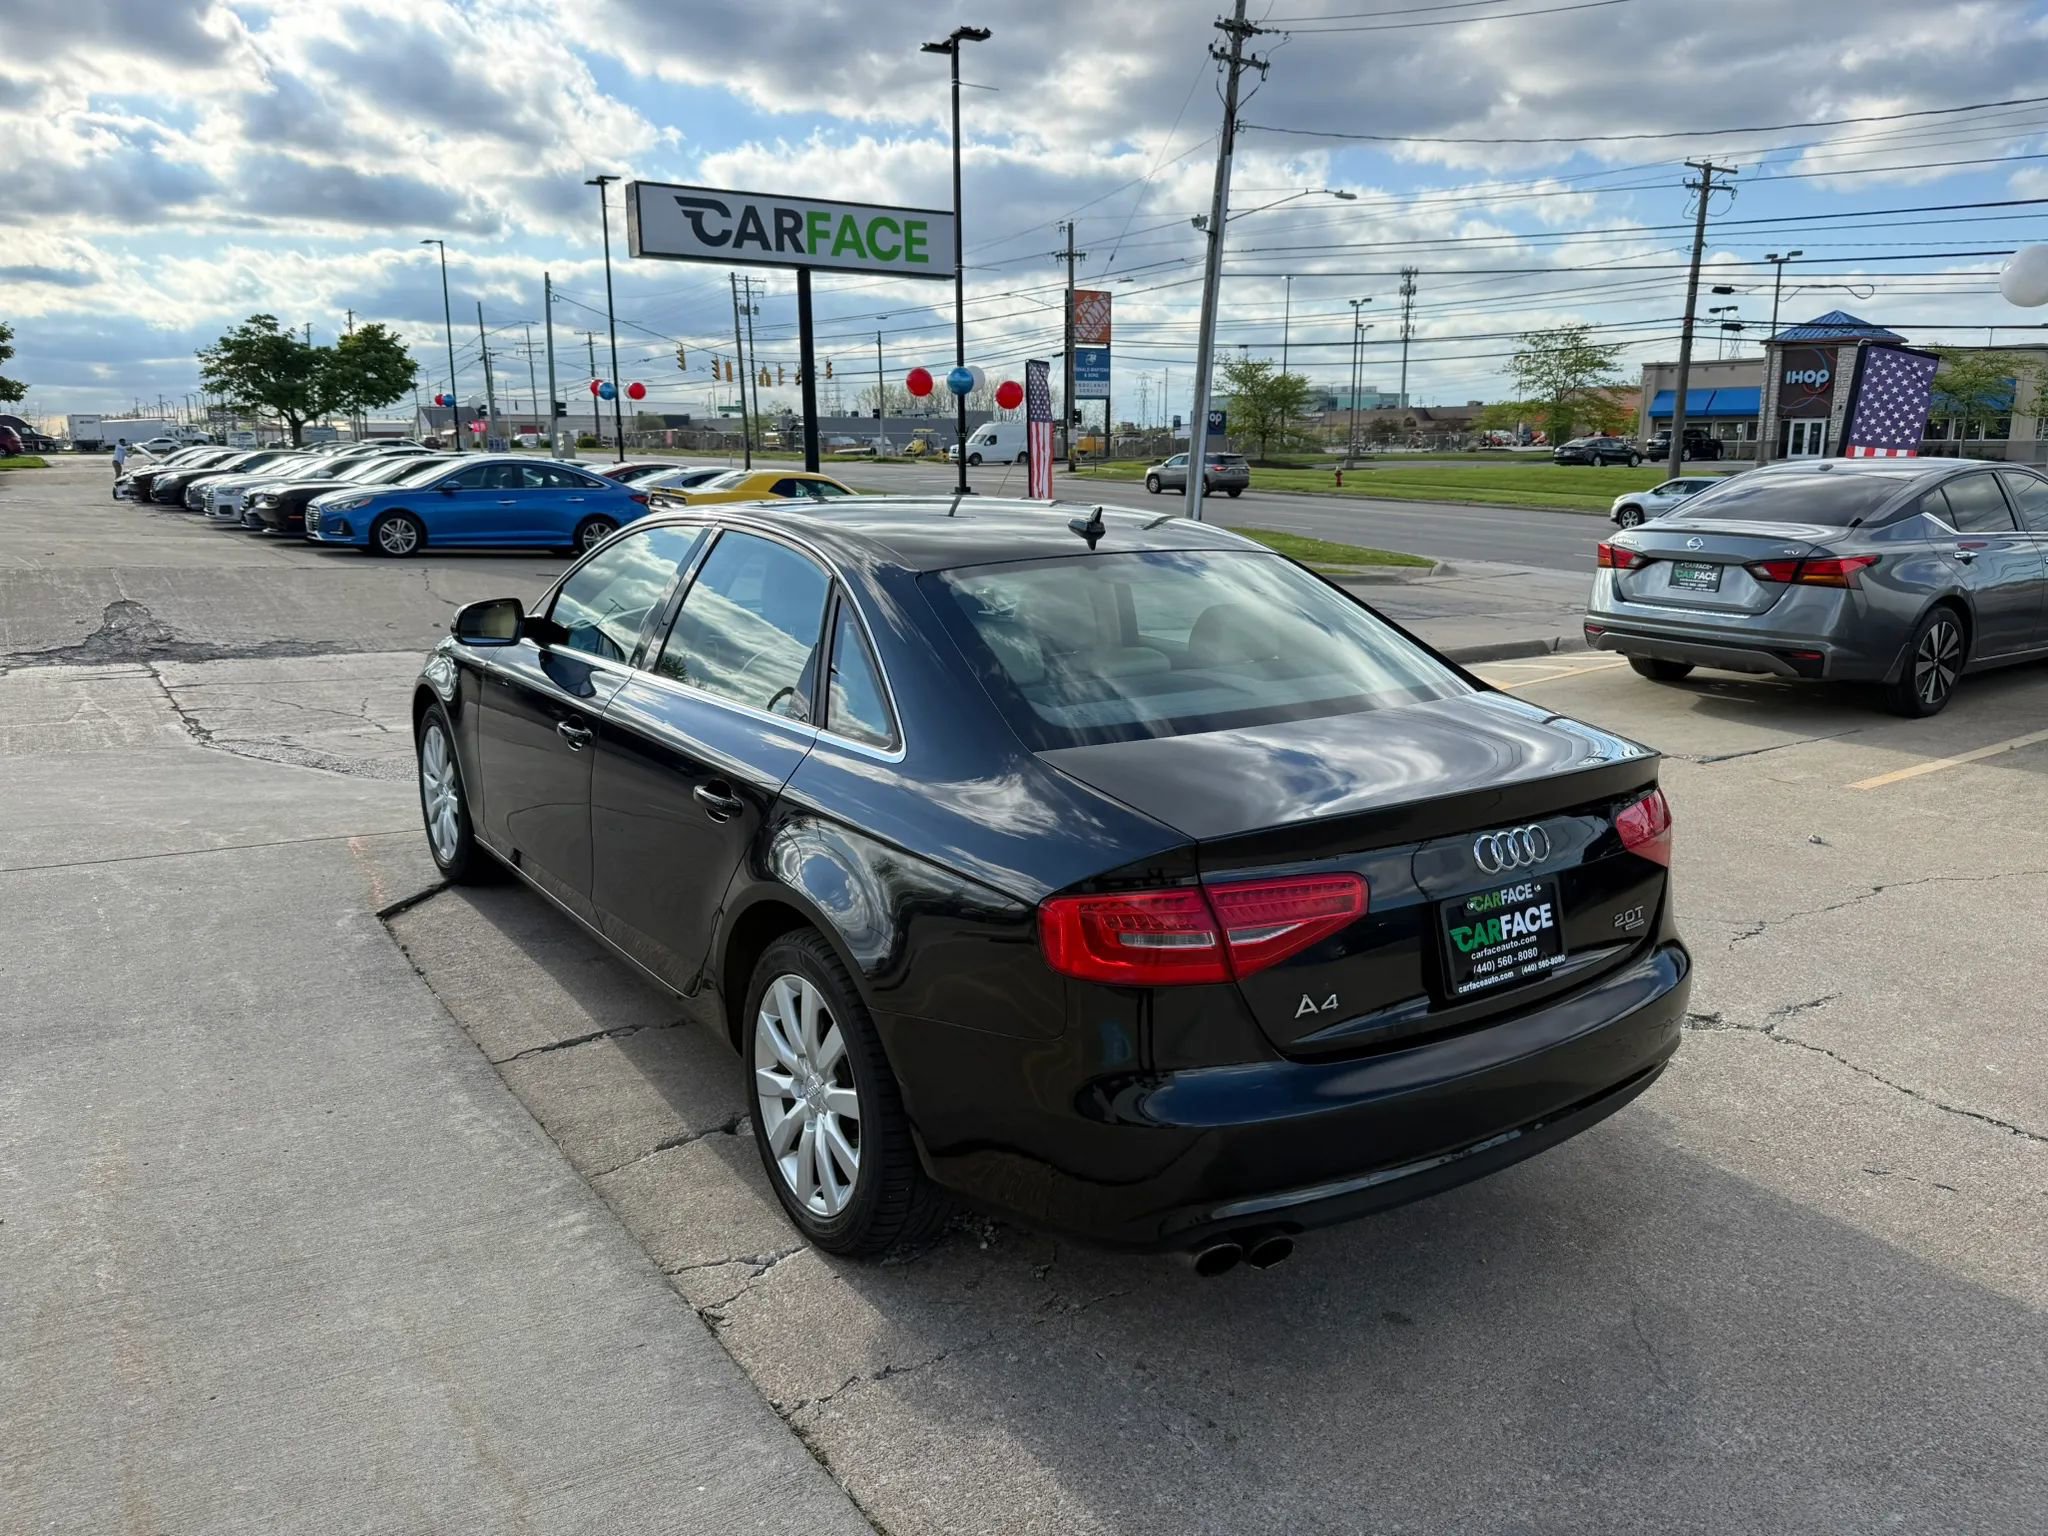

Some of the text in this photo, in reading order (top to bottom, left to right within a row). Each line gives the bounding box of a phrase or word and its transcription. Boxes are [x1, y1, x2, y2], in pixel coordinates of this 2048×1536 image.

[674, 195, 929, 263] CARFACE
[1785, 369, 1830, 388] IHOP
[1674, 569, 1718, 581] CARFACE
[1469, 883, 1533, 912] CARFACE
[1449, 903, 1553, 953] CARFACE
[1471, 935, 1537, 959] carfaceauto.com
[1473, 961, 1495, 974] (440)
[1458, 970, 1514, 993] carfaceauto.com
[1294, 993, 1338, 1018] A4
